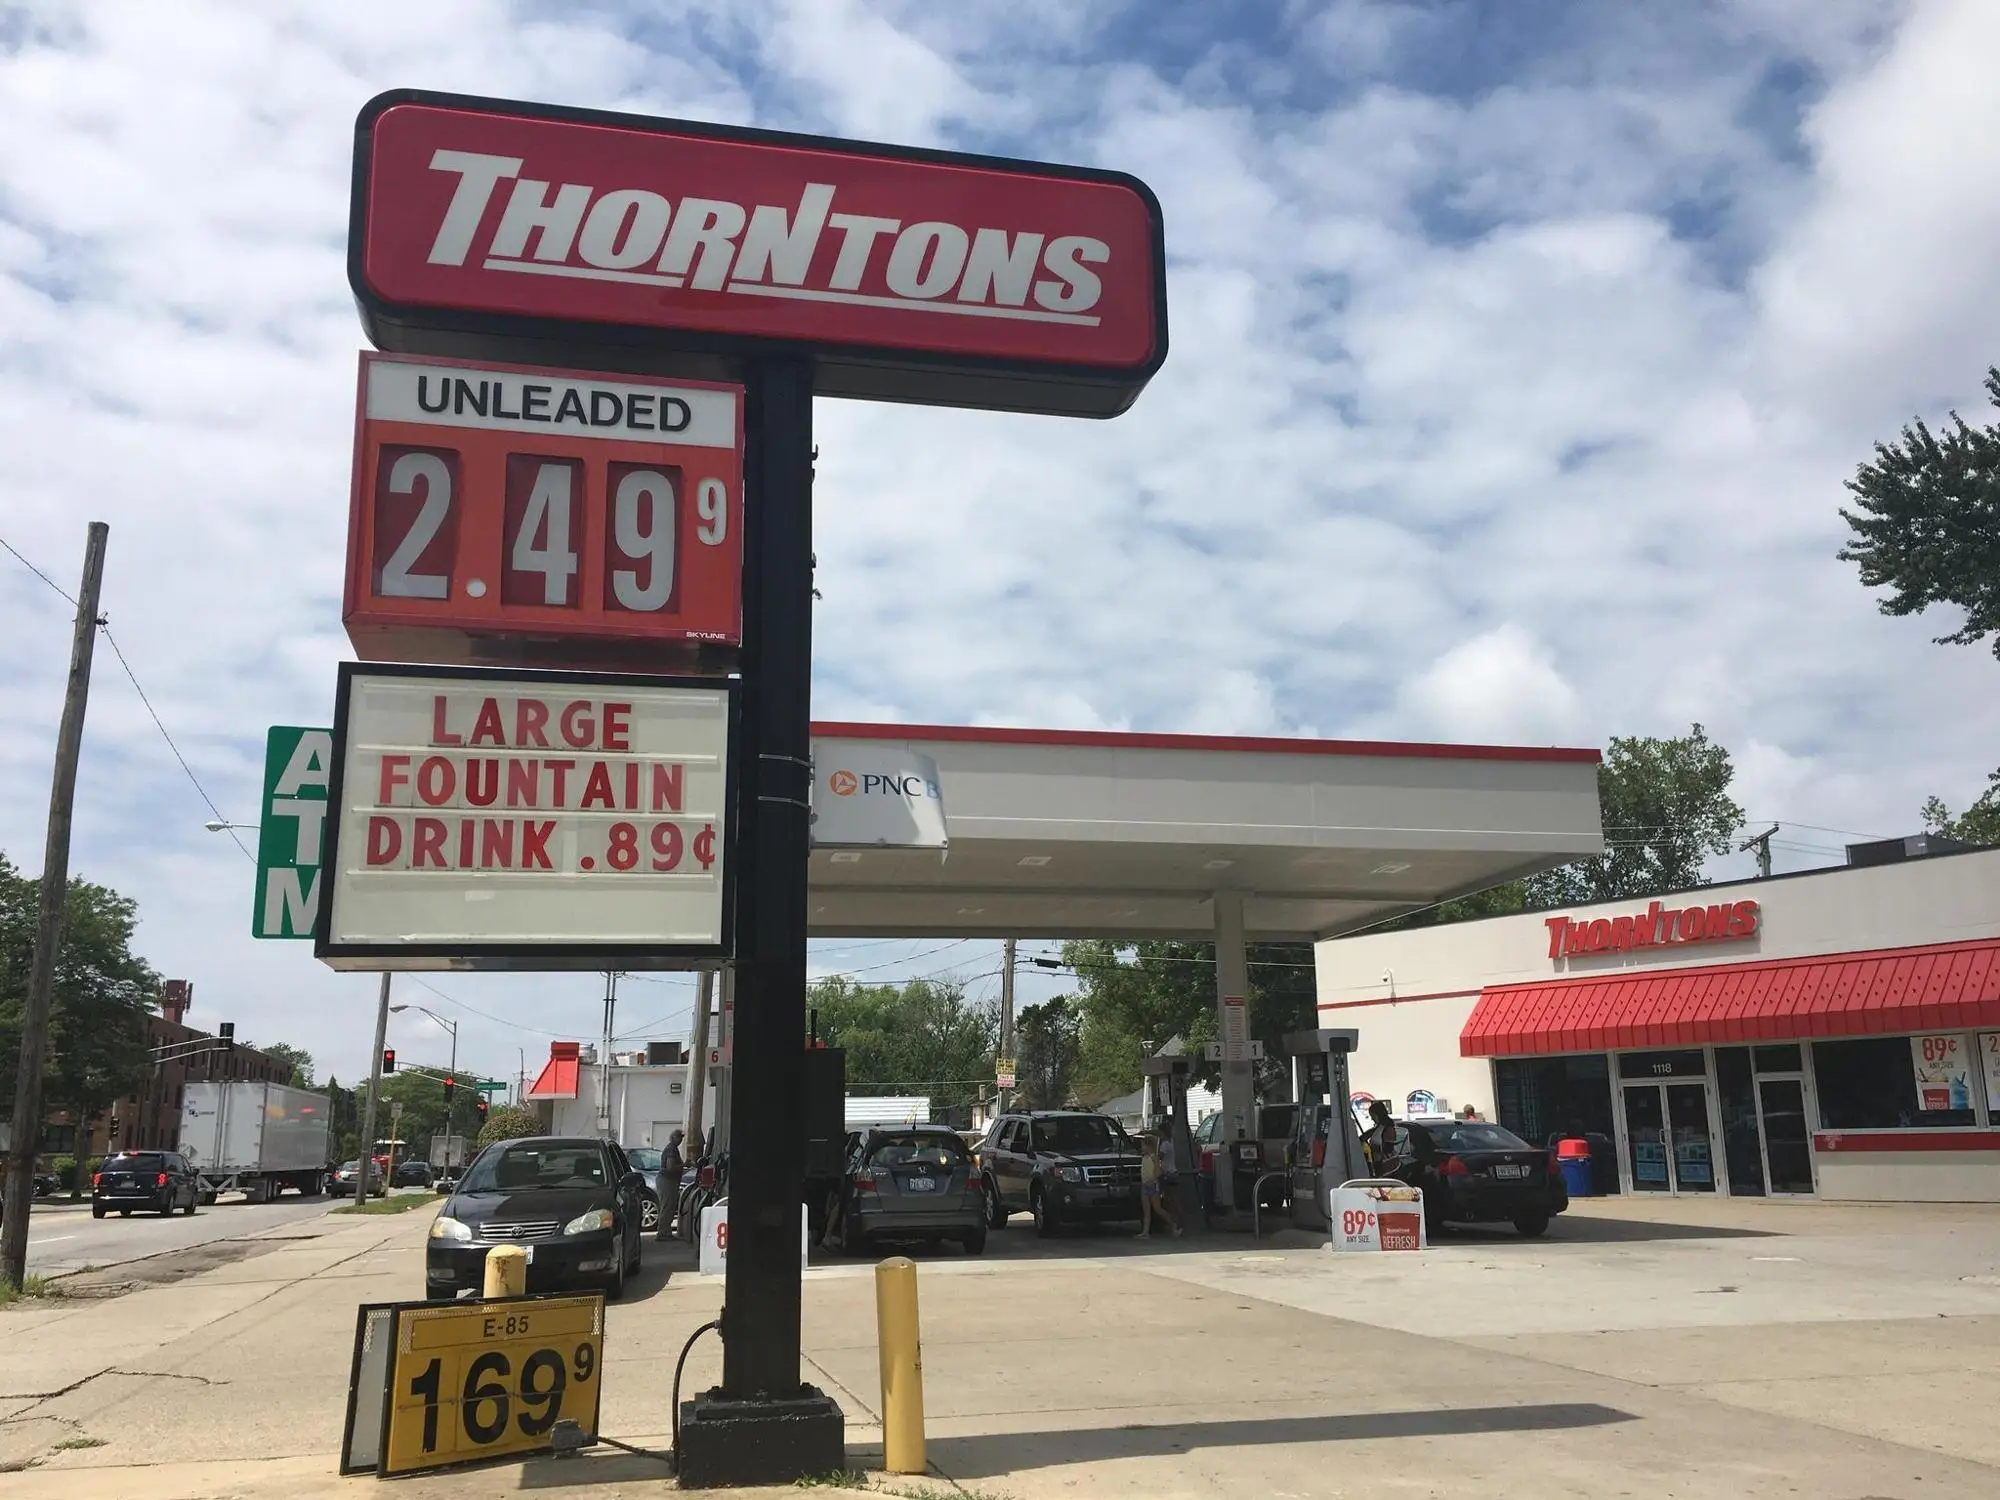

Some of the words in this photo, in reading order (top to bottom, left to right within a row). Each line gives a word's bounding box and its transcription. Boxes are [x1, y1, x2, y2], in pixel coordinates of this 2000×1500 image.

[427, 149, 1111, 314] THORNTONS
[418, 375, 692, 433] UNLEADED
[697, 477, 728, 546] 9
[686, 631, 725, 639] SKYLINE
[432, 695, 632, 750] LARGE
[378, 755, 683, 812] FOUNTAIN
[862, 774, 921, 797] PNC
[263, 730, 333, 936] ATM
[366, 816, 557, 869] DRINK
[580, 822, 717, 872] .89¢
[1545, 900, 1758, 960] THORNTONS
[711, 1051, 719, 1063] 6
[1214, 1045, 1221, 1057] 2
[1251, 1044, 1257, 1056] 1
[1922, 1038, 1957, 1062] 89¢
[1652, 1063, 1672, 1074] 1118
[1343, 1210, 1376, 1235] 89¢
[1346, 1235, 1357, 1243] ANY
[1382, 1235, 1416, 1249] REFRESH
[483, 1315, 529, 1338] E-85
[410, 1348, 567, 1453] 169
[574, 1342, 595, 1383] 9
